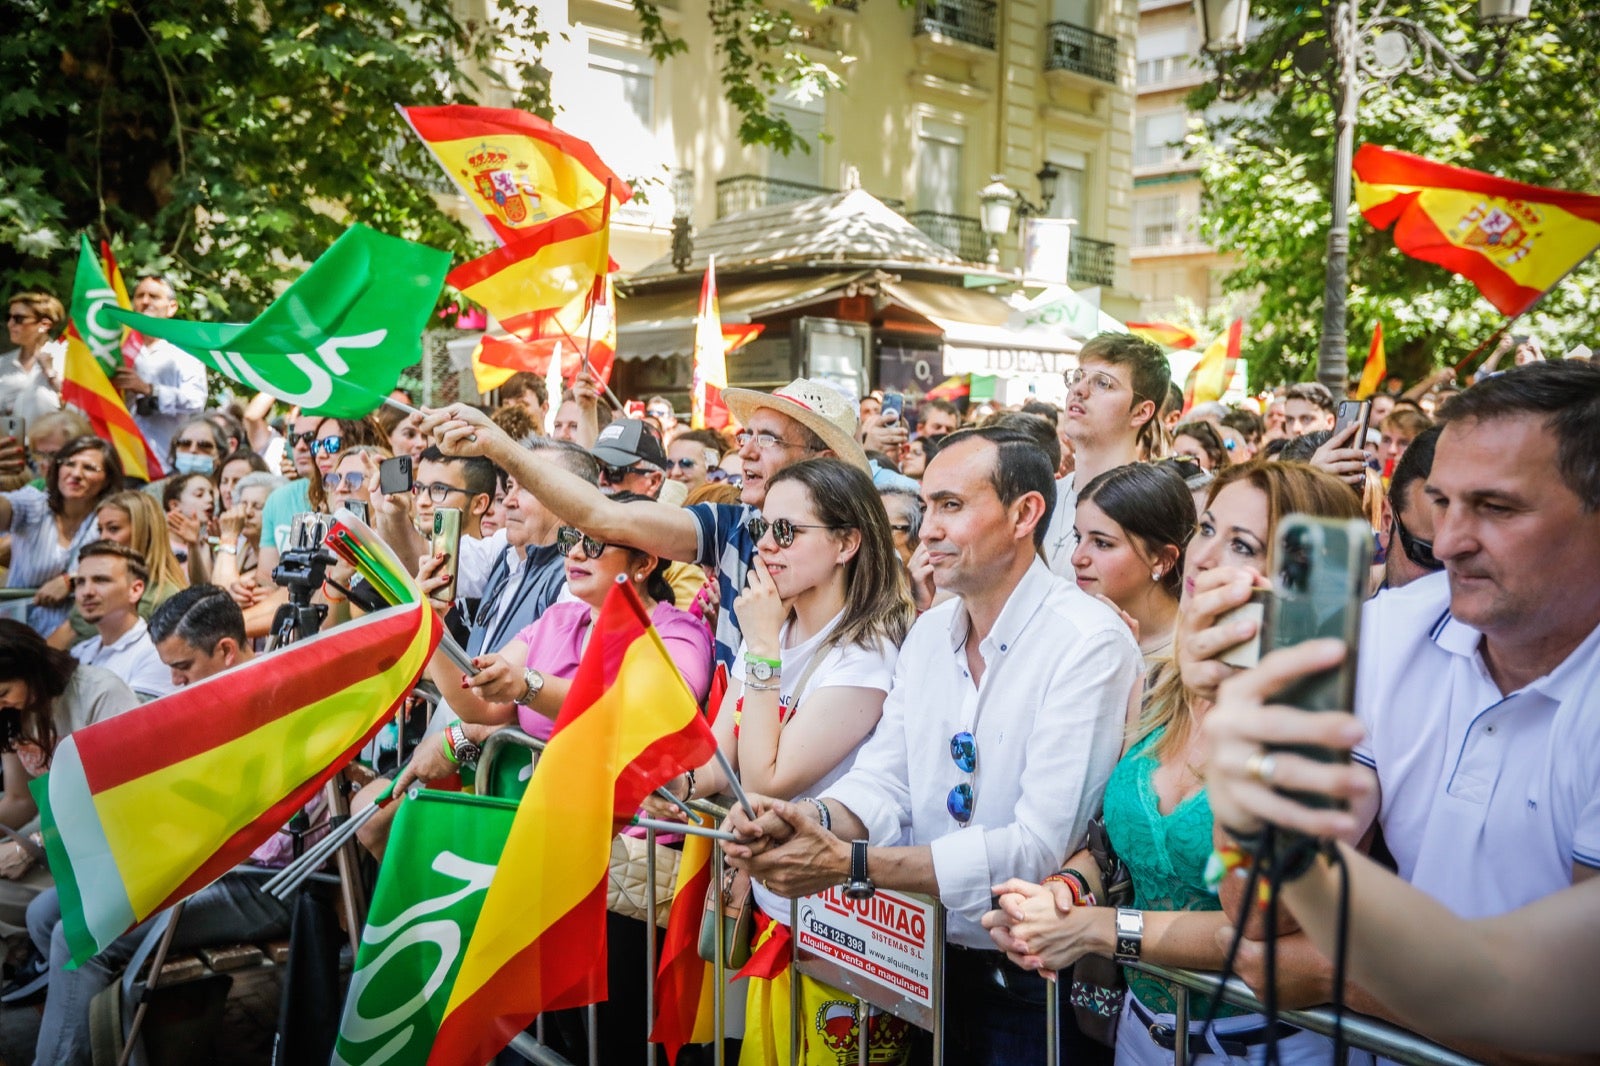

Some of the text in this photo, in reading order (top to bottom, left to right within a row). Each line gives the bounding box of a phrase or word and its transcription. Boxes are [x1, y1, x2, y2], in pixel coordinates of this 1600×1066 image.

[985, 347, 1063, 373] IDEAL
[818, 886, 926, 943] LQUIMAQ
[812, 921, 864, 952] 954 125 398
[871, 931, 925, 961] SISTEMAS S.L.
[802, 934, 927, 997] Alquiler y venta de maquinaria
[868, 948, 929, 980] www.alquimaq.es
